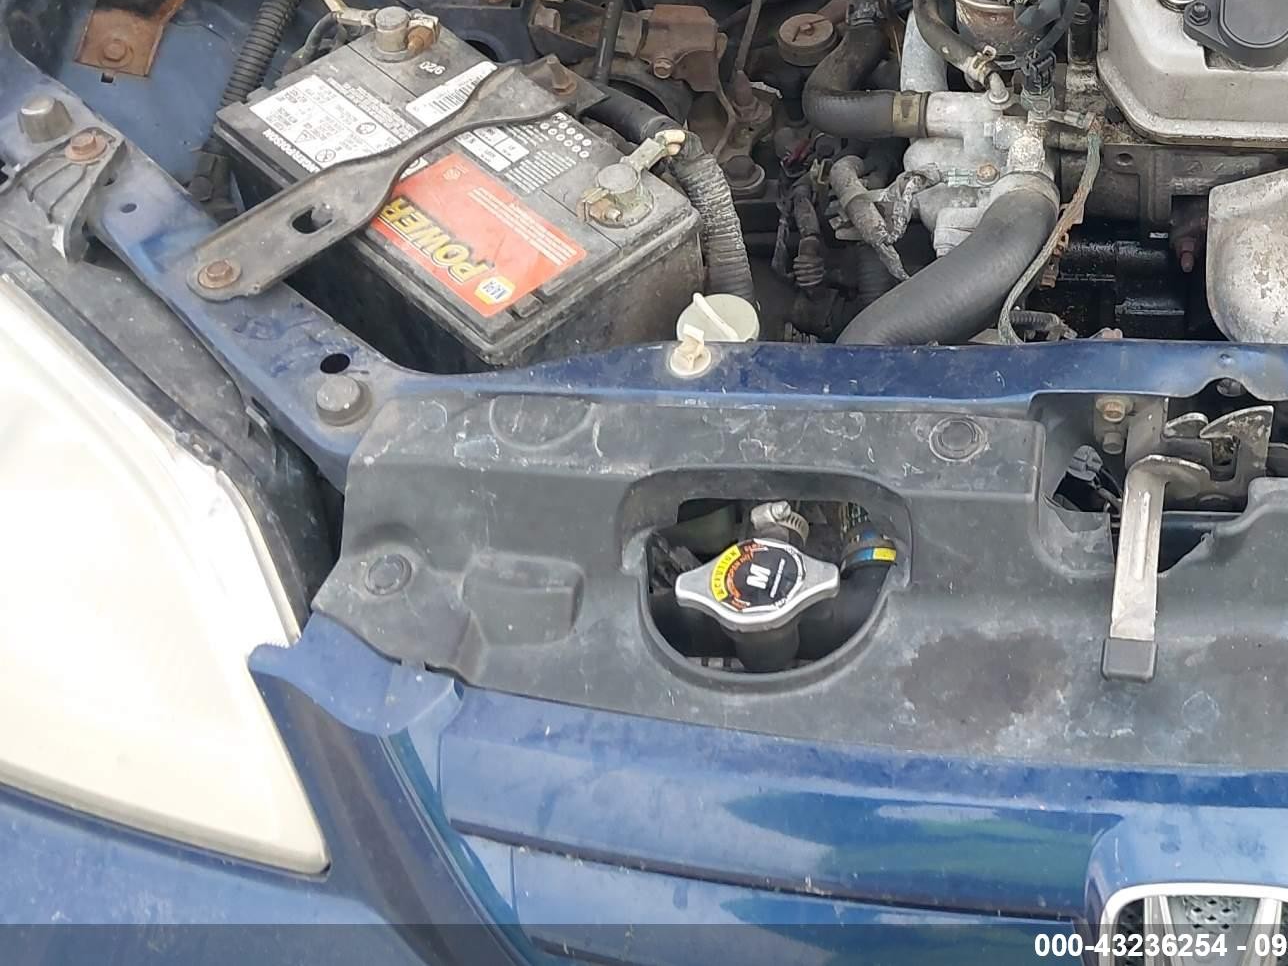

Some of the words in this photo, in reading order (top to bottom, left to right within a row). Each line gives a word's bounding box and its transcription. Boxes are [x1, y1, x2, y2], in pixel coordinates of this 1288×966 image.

[378, 195, 493, 285] POWER
[484, 281, 508, 301] NAPA
[746, 563, 772, 589] M
